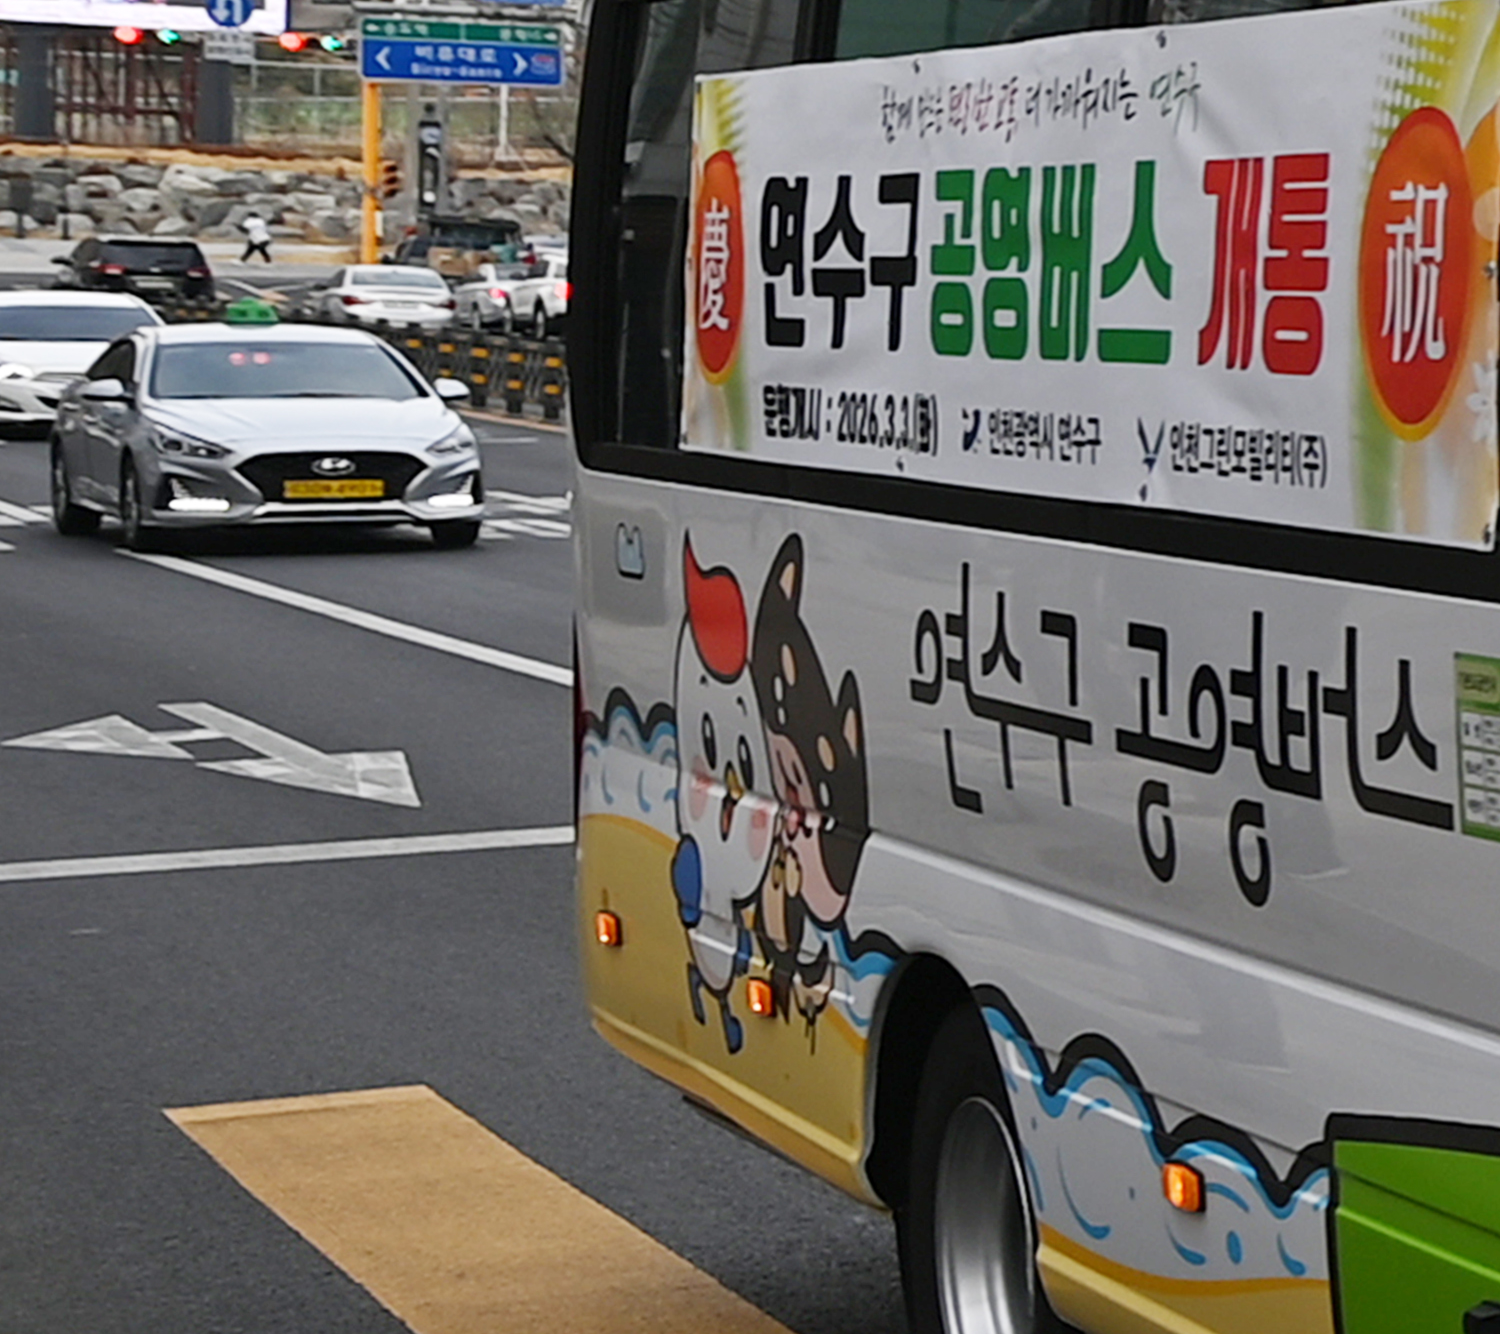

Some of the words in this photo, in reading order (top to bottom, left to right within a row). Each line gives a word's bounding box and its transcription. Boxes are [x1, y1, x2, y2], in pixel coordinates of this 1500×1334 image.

[700, 196, 731, 332] 慶
[761, 170, 921, 352] 연수구
[930, 160, 1173, 366] 공영버스
[1198, 152, 1331, 375] 개통
[1381, 181, 1449, 365] 祝
[988, 408, 1054, 461] 인천광역시
[1058, 414, 1101, 465] 연수구
[909, 561, 1093, 816] 연수구
[1116, 610, 1455, 908] 공영버스
